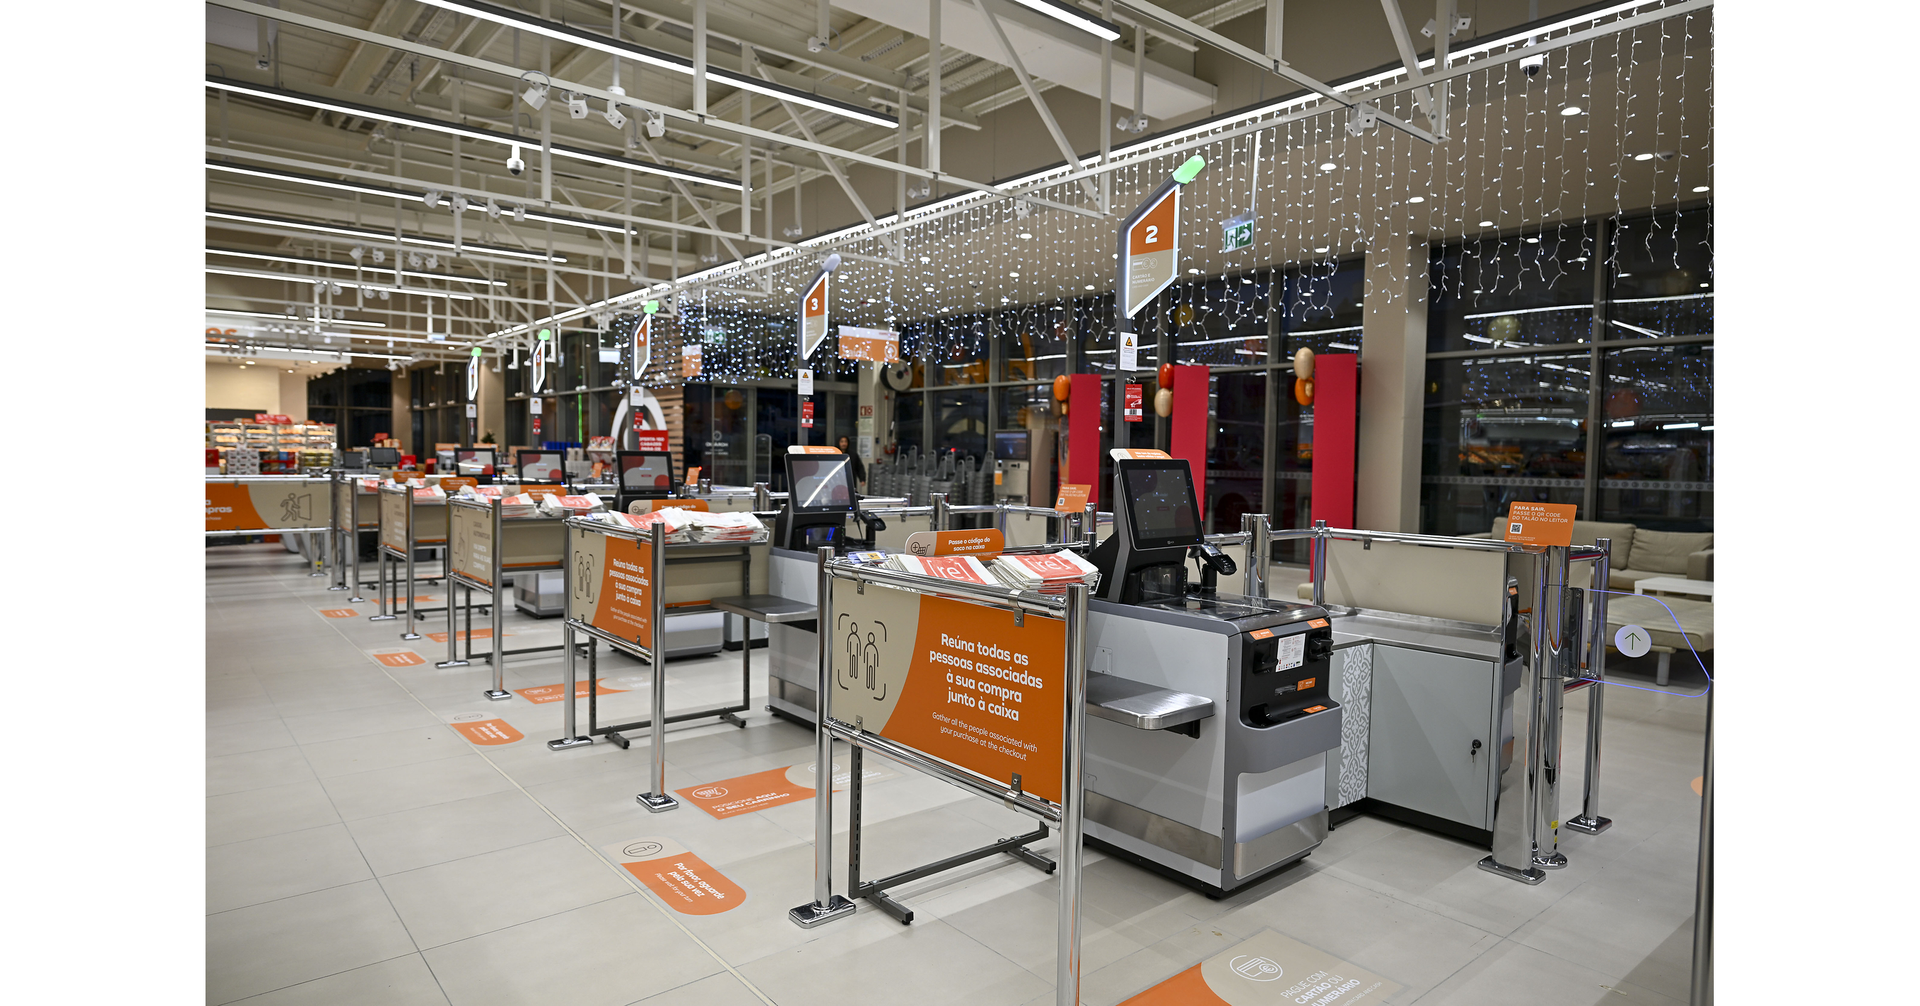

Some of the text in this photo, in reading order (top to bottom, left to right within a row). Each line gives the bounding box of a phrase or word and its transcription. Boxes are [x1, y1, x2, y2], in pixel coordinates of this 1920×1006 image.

[1145, 225, 1158, 244] 2
[811, 297, 818, 311] 3
[968, 537, 983, 545] código
[609, 569, 649, 586] pessoas associadas
[626, 562, 638, 572] todas
[639, 566, 644, 574] as
[941, 633, 1029, 665] Reúna todas as
[930, 650, 1043, 689] pessoas associadas
[946, 669, 1022, 703] à sua compra
[947, 687, 1019, 721] junto à caixa
[932, 712, 951, 724] Gather
[959, 720, 968, 729] the
[968, 724, 988, 736] people
[989, 730, 1022, 748] associated
[1023, 742, 1038, 753] with
[940, 726, 1027, 761] your purchase at the checkout
[667, 871, 705, 897] pela sua vez
[674, 862, 725, 900] Por favor, aguarde
[1280, 970, 1329, 998] PAGUE COM
[1294, 974, 1344, 1004] CARTÃO OU
